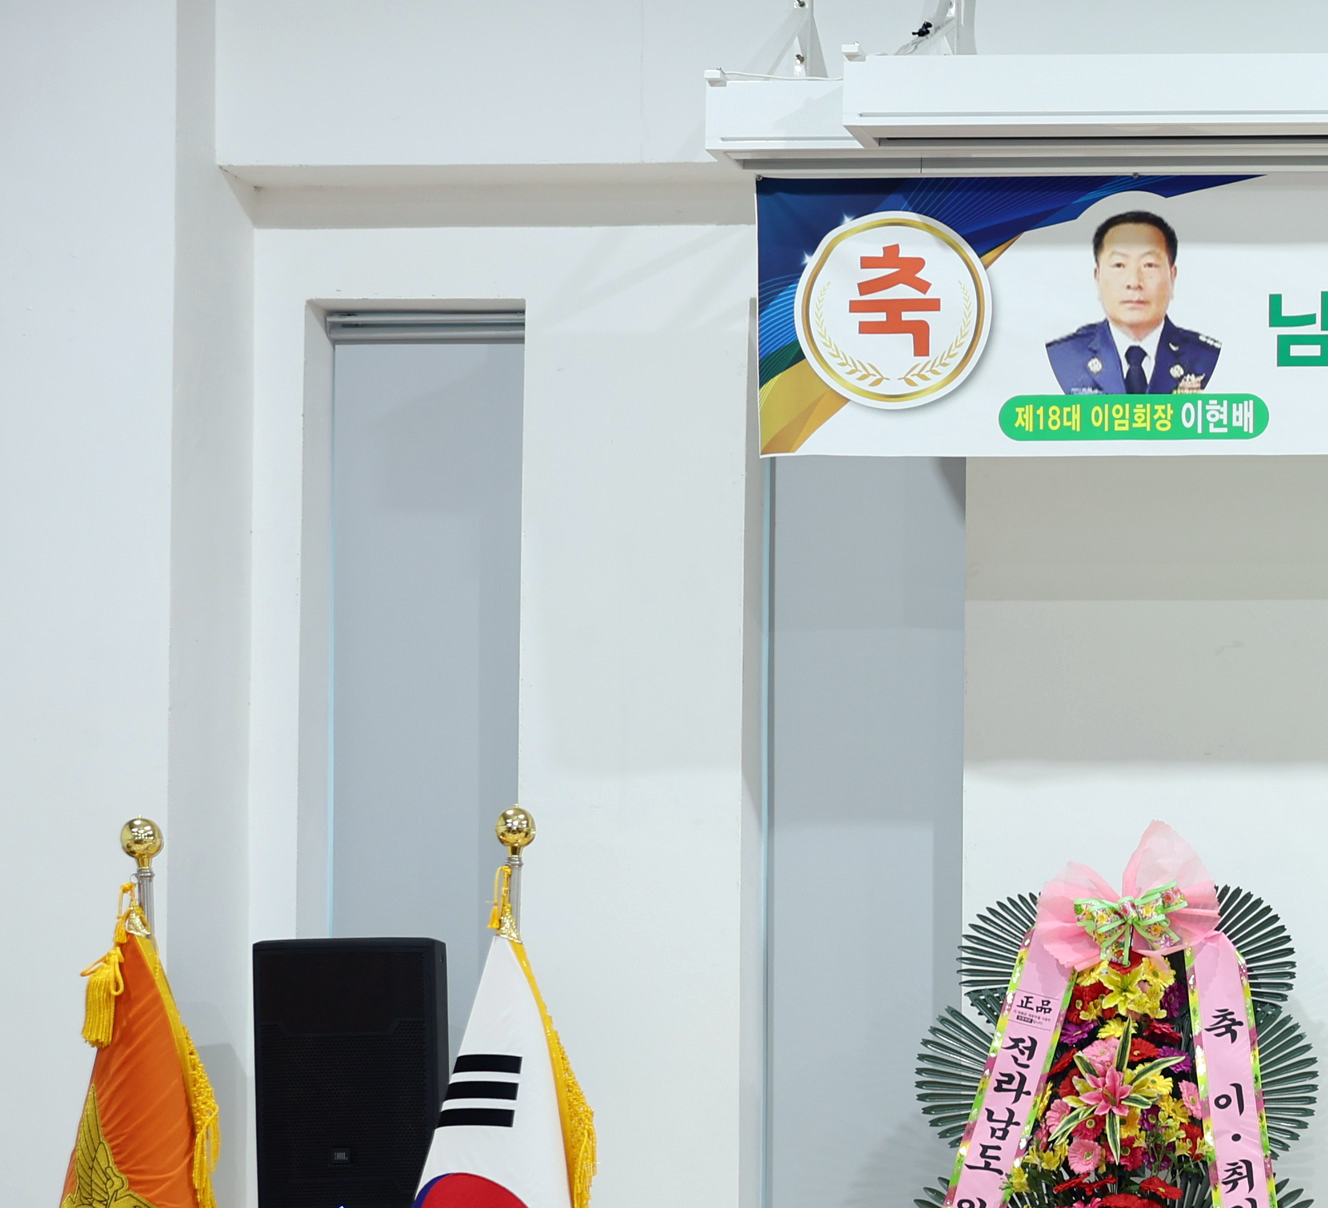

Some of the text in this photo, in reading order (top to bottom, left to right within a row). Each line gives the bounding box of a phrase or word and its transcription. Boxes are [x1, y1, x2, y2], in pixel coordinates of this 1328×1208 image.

[848, 244, 942, 358] 축
[1013, 402, 1255, 435] 제18대 이임회장 이현배
[1016, 995, 1052, 1014] 正品
[1205, 1007, 1244, 1044] 축
[965, 1034, 1040, 1177] 전라남도
